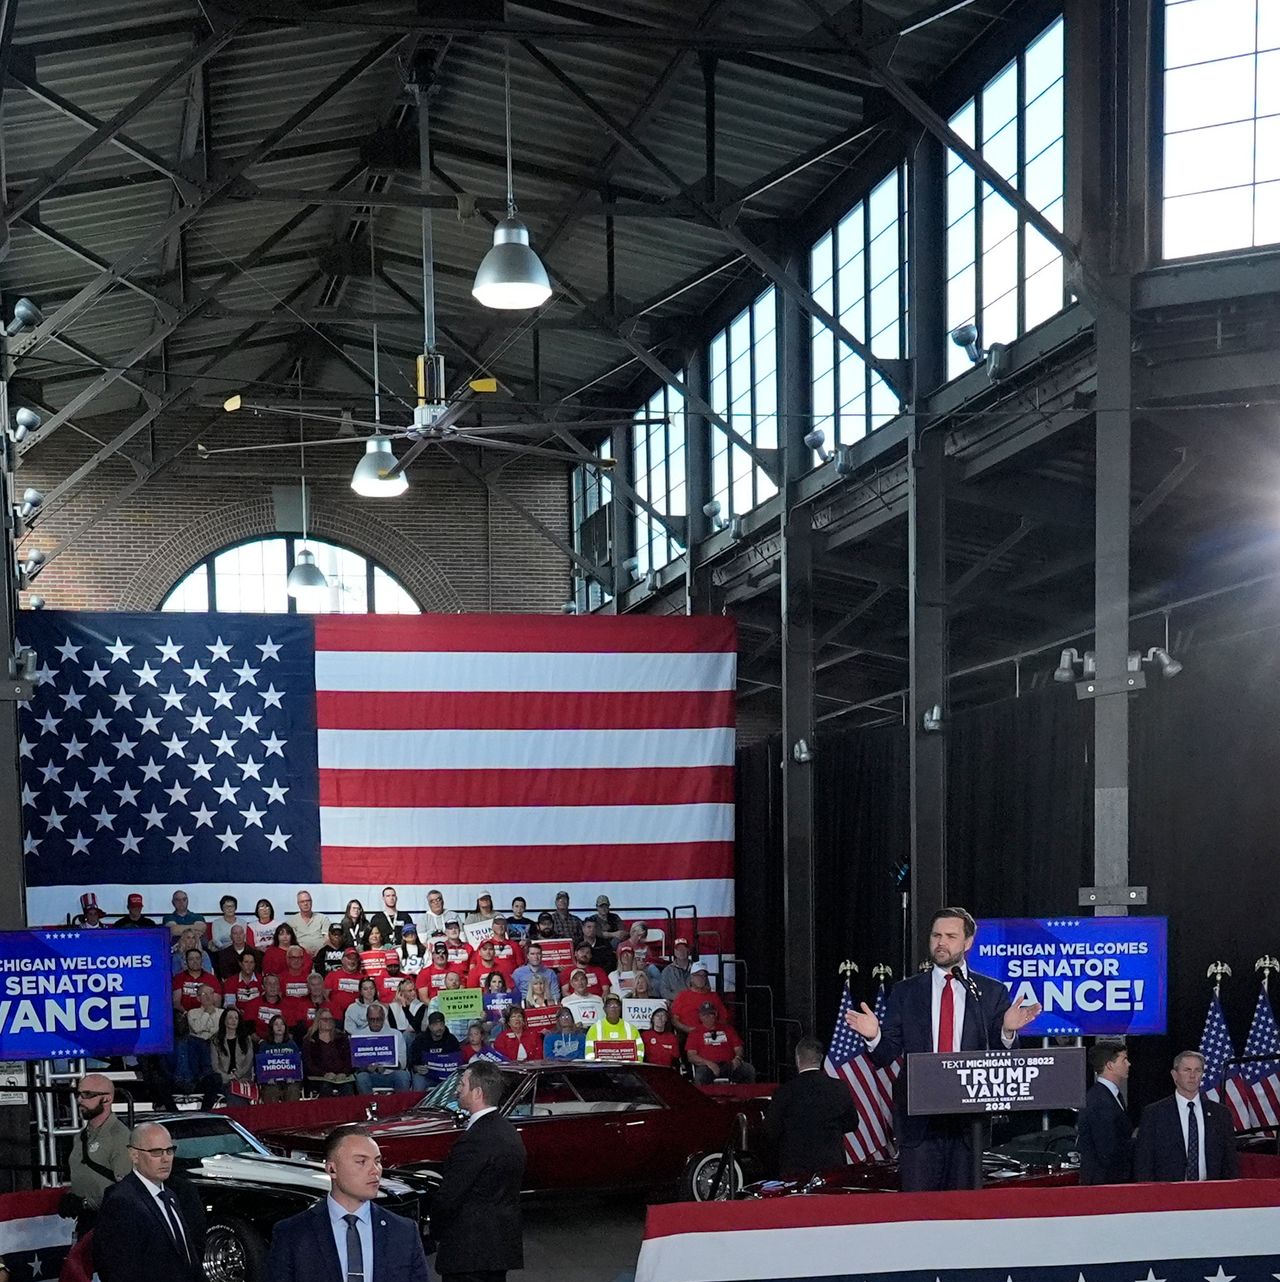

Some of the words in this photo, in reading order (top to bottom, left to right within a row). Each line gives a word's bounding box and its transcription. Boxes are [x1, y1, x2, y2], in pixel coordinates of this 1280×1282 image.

[980, 944, 1056, 956] MICHIGAN
[1060, 942, 1148, 955] WELCOMES
[60, 955, 153, 972] WELCOMES
[1007, 959, 1120, 977] SENATOR
[5, 974, 124, 996] SENATOR
[1004, 980, 1144, 1012] ANCE!
[941, 1060, 964, 1069] TEXT
[966, 1059, 1011, 1068] MICHIGAN
[1013, 1058, 1026, 1067] TO
[1027, 1057, 1055, 1066] 88022
[957, 1067, 1039, 1085] TRUMP
[966, 1082, 1031, 1098] VANCE
[985, 1102, 1011, 1111] 2024
